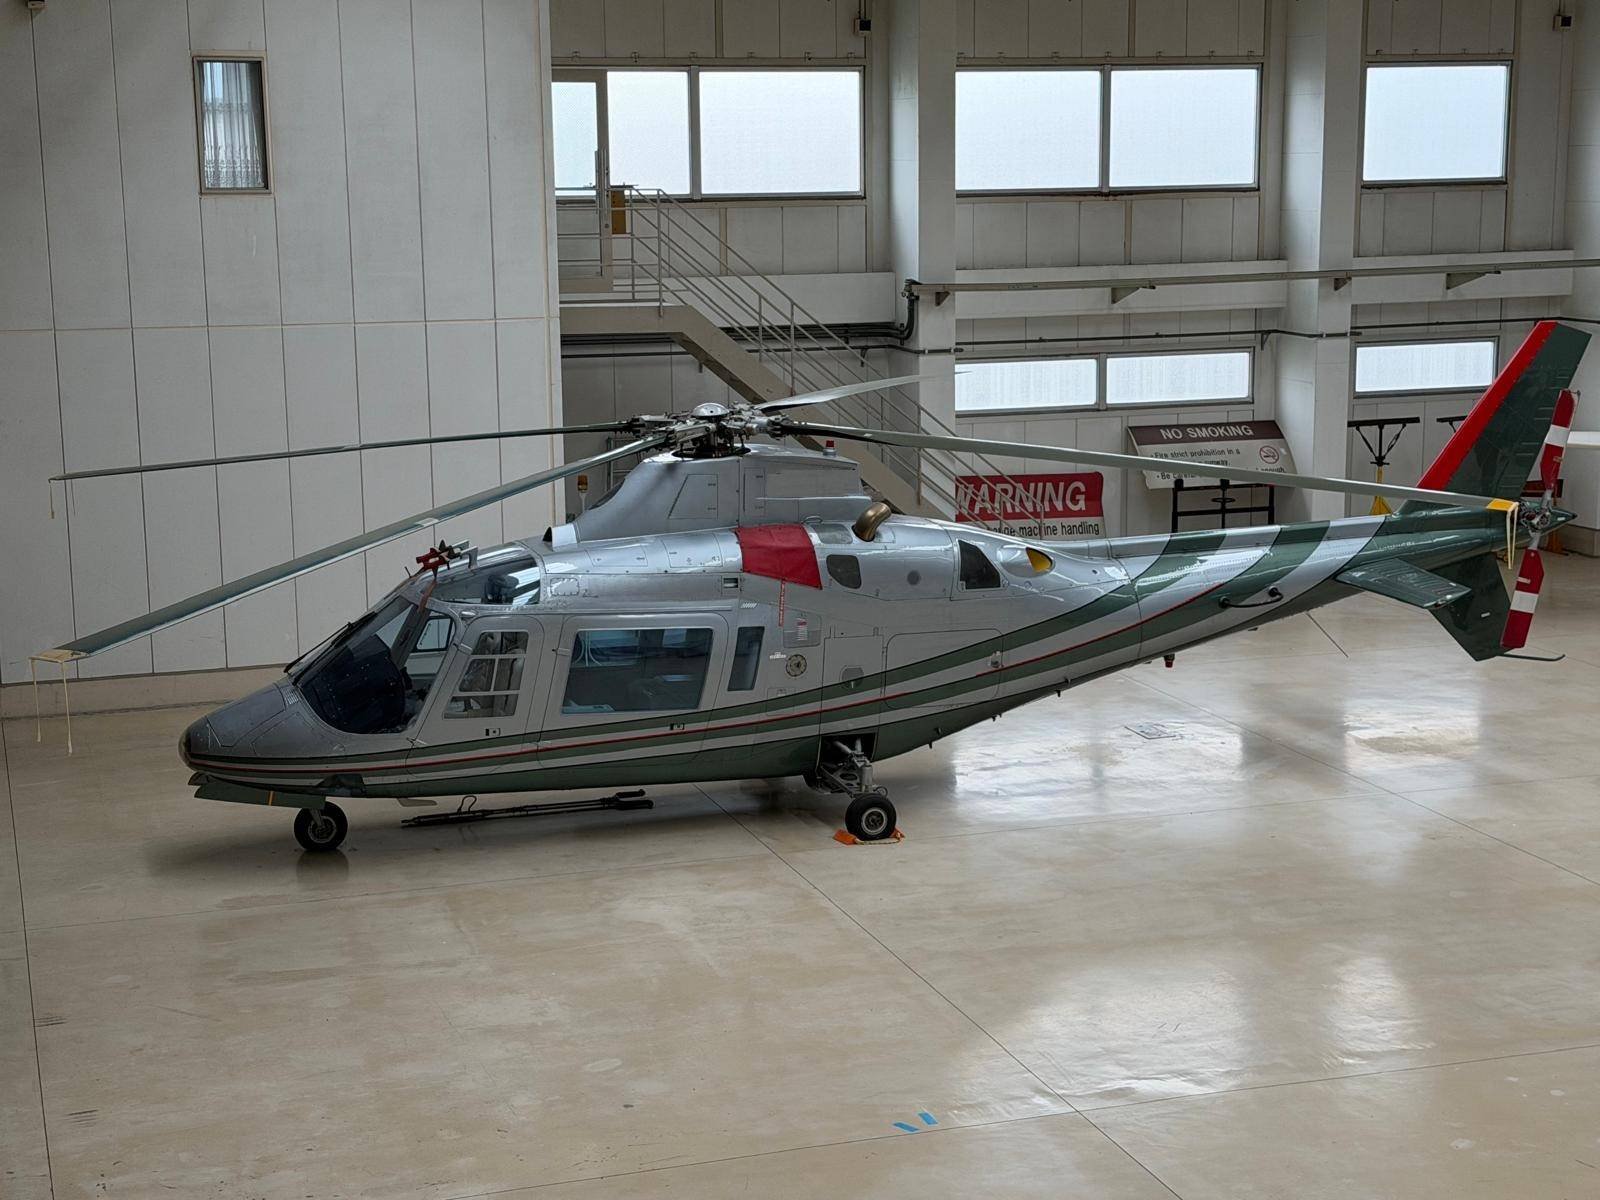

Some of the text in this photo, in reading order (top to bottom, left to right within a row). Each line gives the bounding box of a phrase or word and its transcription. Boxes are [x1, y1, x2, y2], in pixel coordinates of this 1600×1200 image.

[1160, 425, 1254, 440] NO SMOKING
[1170, 449, 1189, 458] strict
[1190, 448, 1226, 459] prohibition
[1227, 447, 1234, 455] in
[956, 480, 1086, 515] WARNING
[1018, 523, 1058, 537] macine
[1061, 521, 1100, 536] handling
